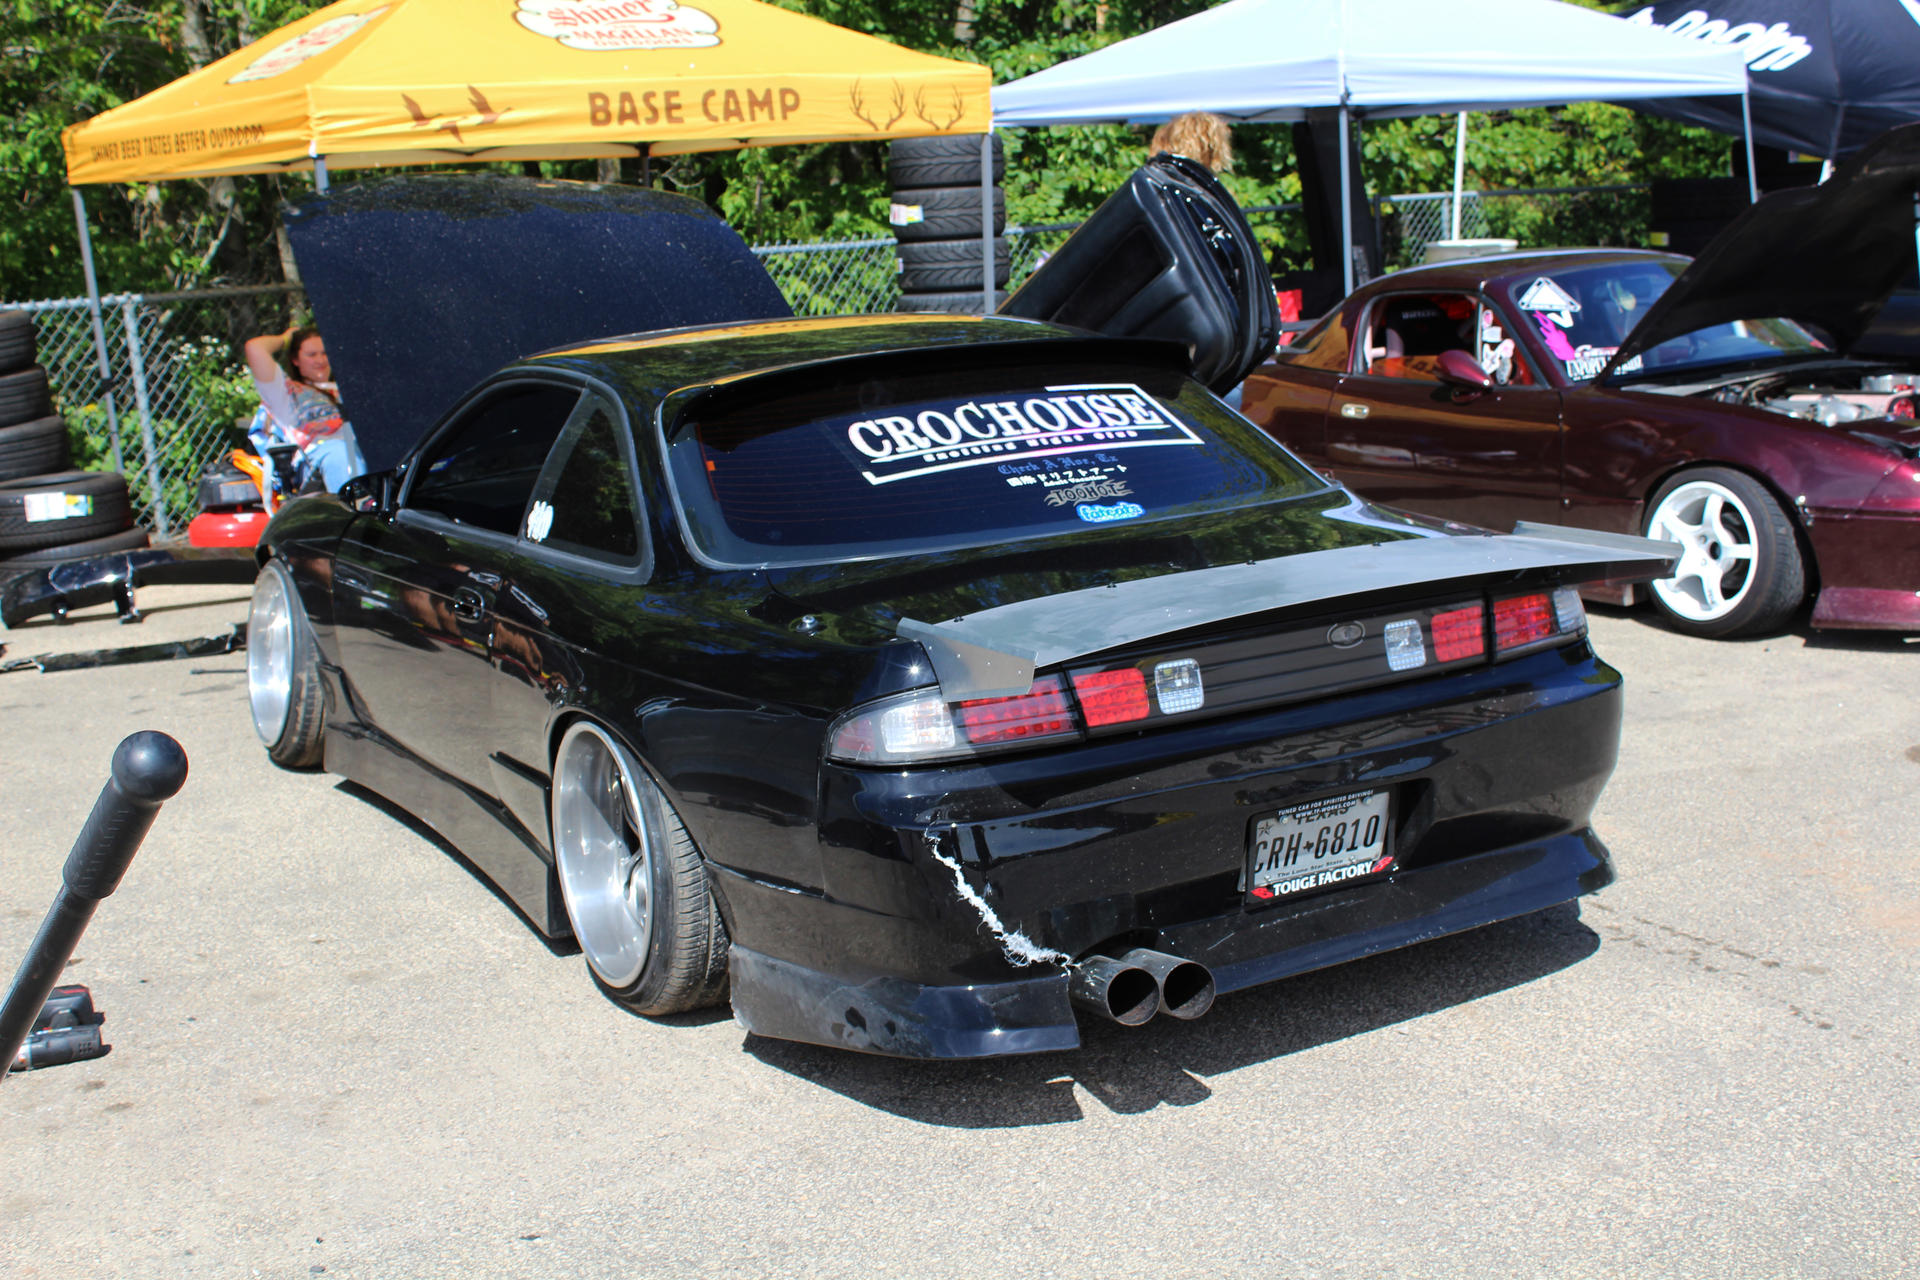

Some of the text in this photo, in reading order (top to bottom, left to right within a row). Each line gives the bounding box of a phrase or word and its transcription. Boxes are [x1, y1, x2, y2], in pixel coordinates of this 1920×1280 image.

[572, 27, 694, 40] MAGELLAN
[588, 88, 801, 126] BASE CAMP
[121, 138, 142, 160] BEER
[143, 135, 171, 157] TASTES
[174, 129, 207, 153] BETTER
[848, 393, 1164, 459] CROCHOUSE
[1273, 861, 1374, 896] TOUGE FACTORY
